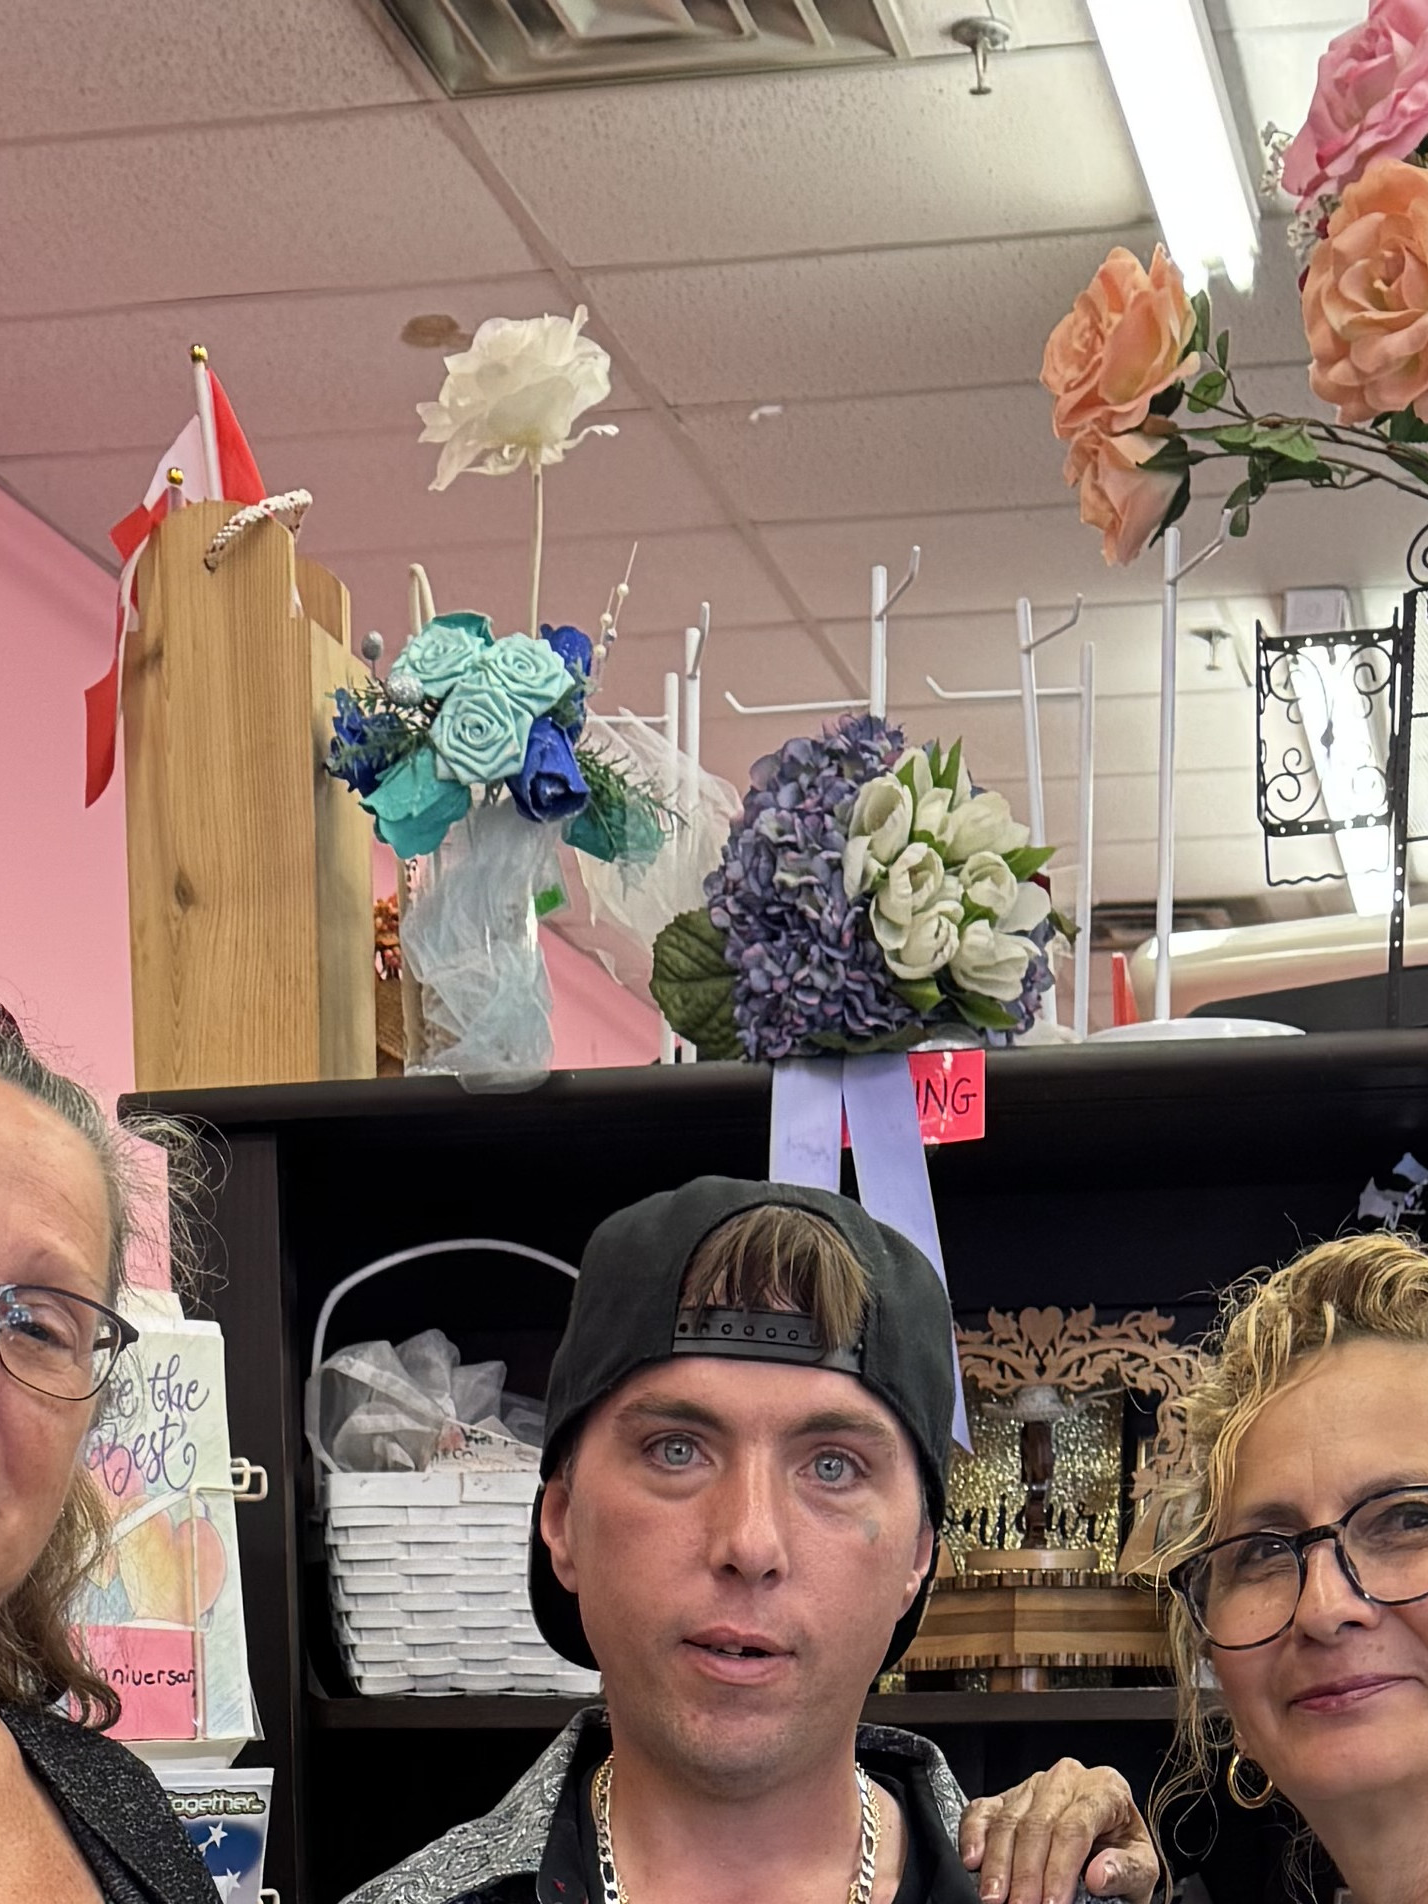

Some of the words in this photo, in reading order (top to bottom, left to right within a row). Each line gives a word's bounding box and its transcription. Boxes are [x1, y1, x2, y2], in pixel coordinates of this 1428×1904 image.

[915, 1077, 977, 1115] ING
[148, 1354, 210, 1412] the
[98, 1663, 196, 1698] nniversar
